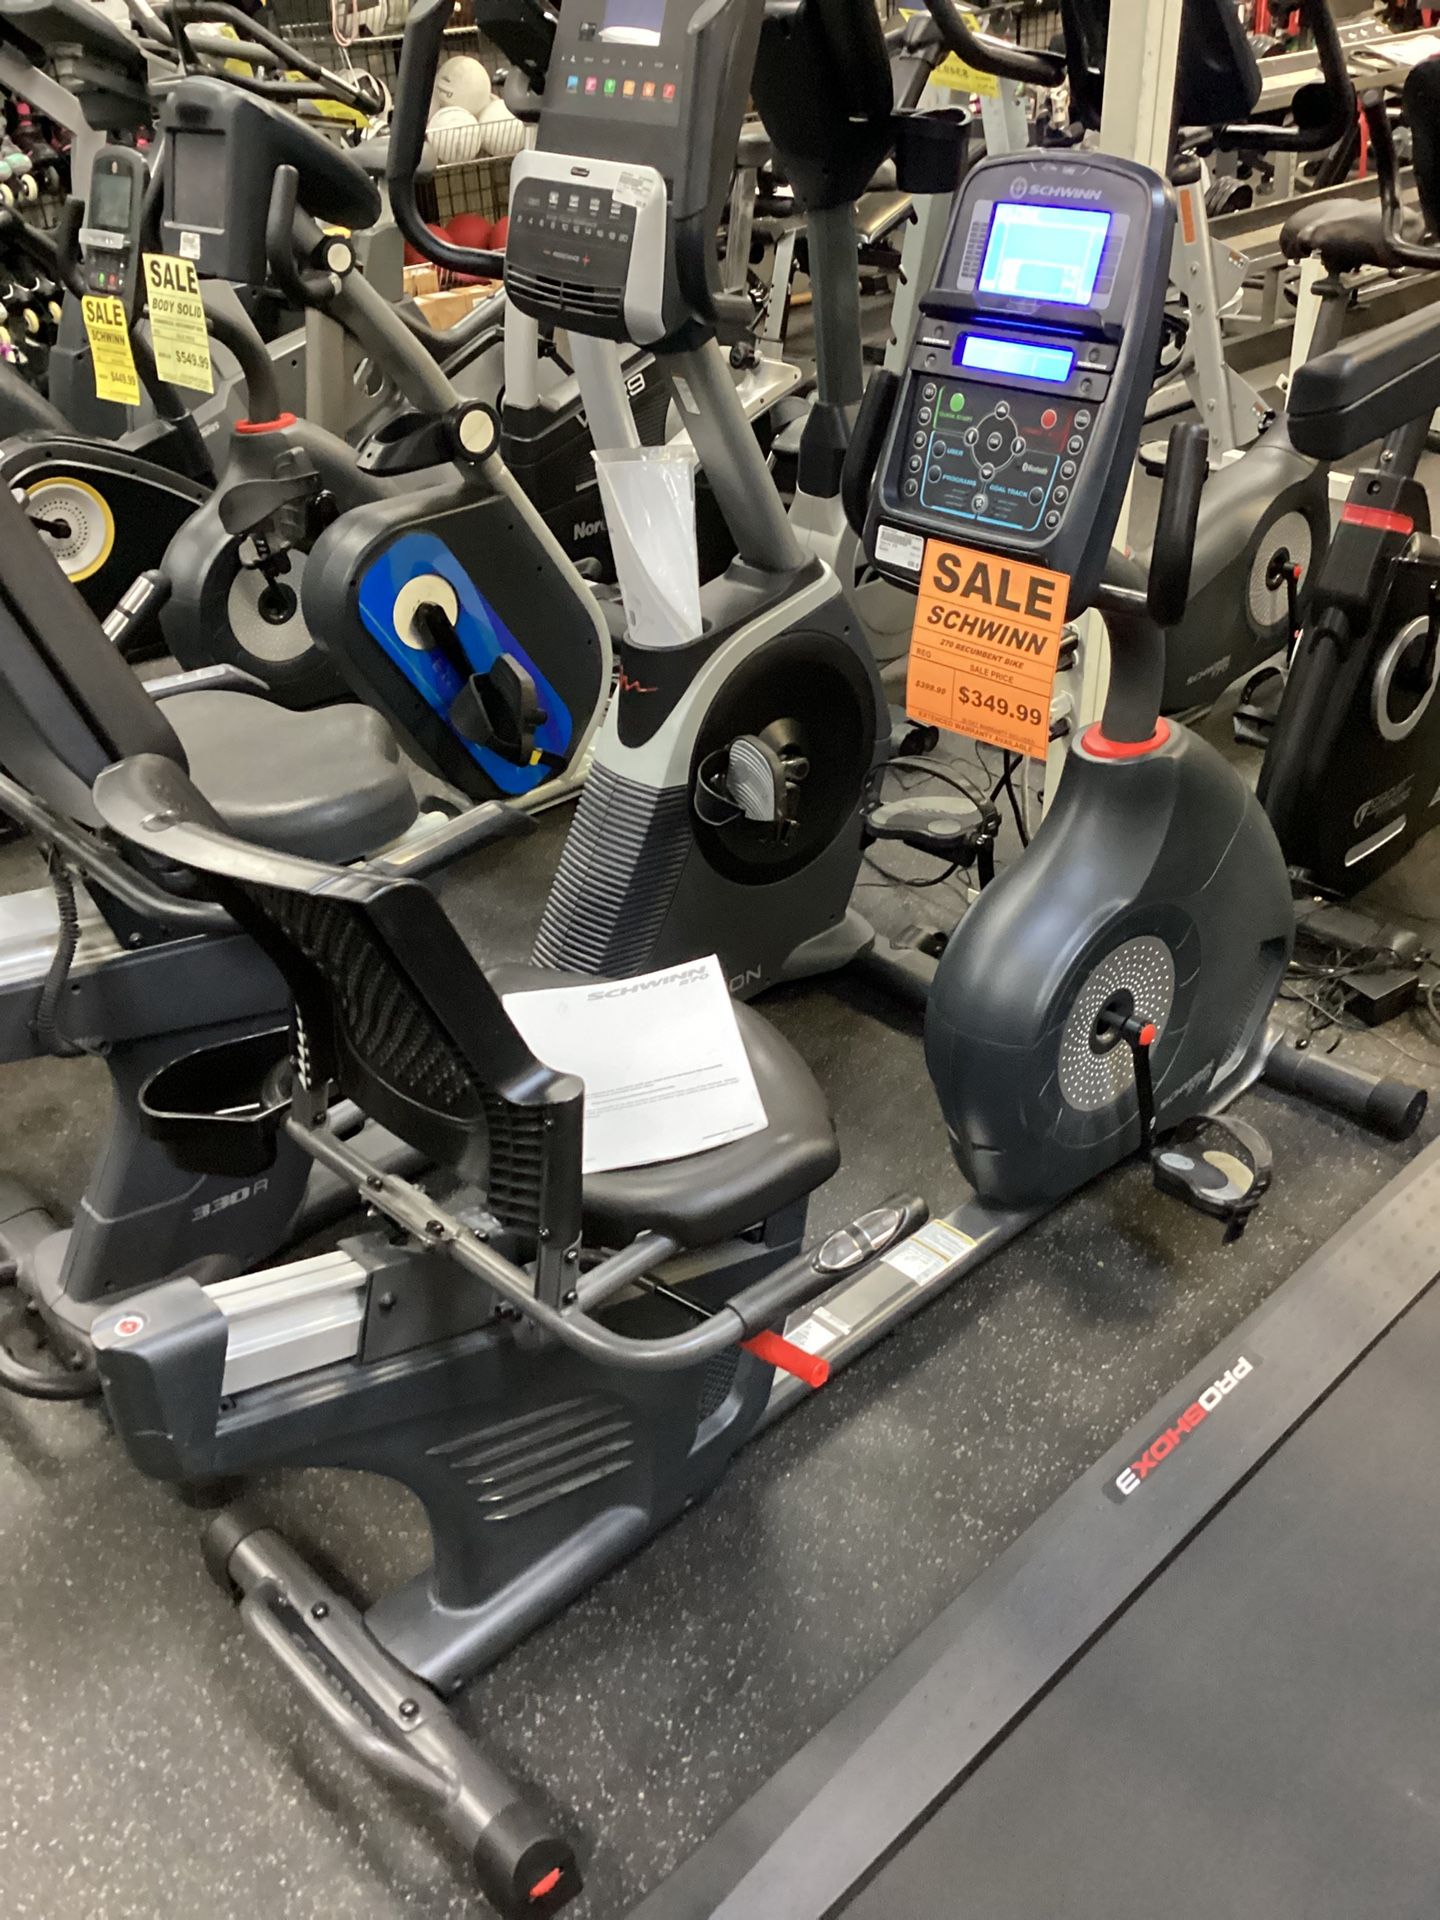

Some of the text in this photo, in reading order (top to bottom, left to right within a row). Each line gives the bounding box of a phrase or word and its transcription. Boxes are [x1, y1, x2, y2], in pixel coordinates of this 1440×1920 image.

[1028, 184, 1102, 200] SCHWINN
[151, 260, 198, 294] SALE
[86, 301, 123, 326] SALE
[152, 298, 202, 318] BODY SOLID
[92, 329, 126, 346] SCHWINN
[175, 351, 209, 370] $549.99
[933, 552, 1055, 621] SALE
[927, 605, 1048, 655] SCHWINN
[916, 647, 932, 658] REG
[940, 638, 1024, 670] 270 RECUMBENT BIKE
[970, 664, 1014, 683] SALE PRICE
[958, 686, 1042, 726] $349.99
[918, 711, 1033, 752] EXTENDED WARRANTY AVAILABLE
[586, 966, 706, 1001] SCHWINN
[679, 973, 710, 987] 270
[192, 1187, 250, 1222] 330
[1116, 1356, 1253, 1495] PROSHOX3
